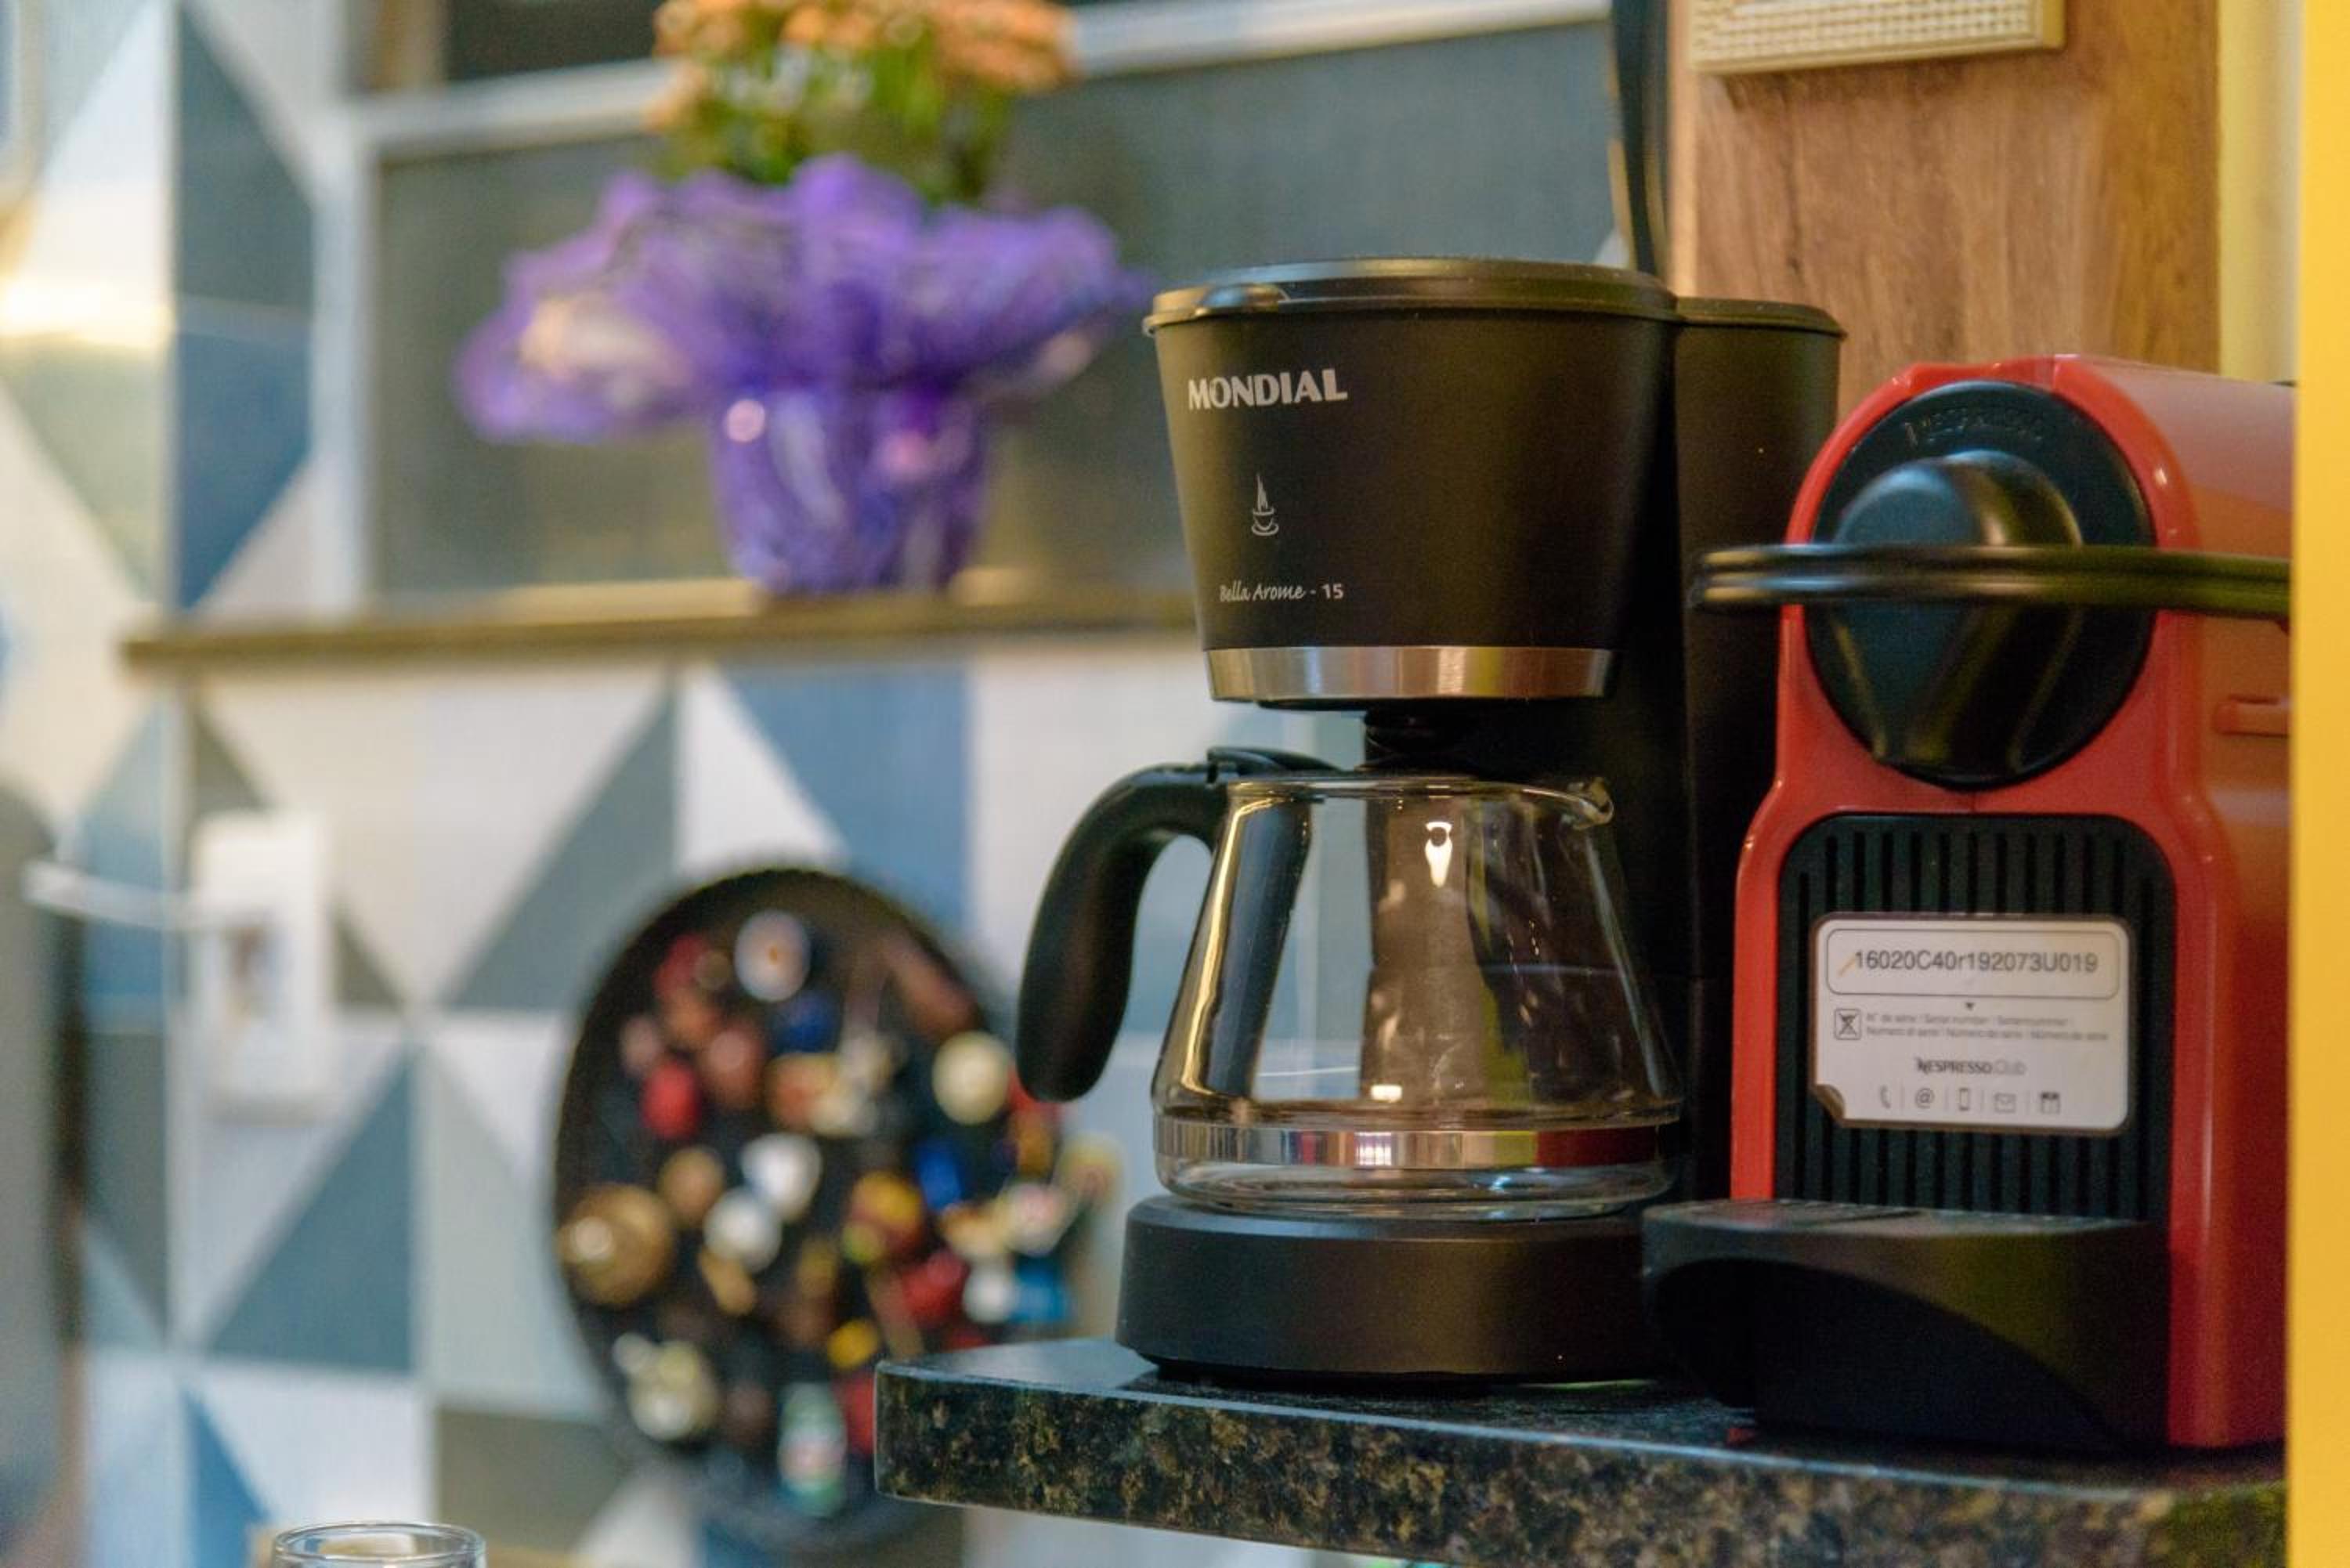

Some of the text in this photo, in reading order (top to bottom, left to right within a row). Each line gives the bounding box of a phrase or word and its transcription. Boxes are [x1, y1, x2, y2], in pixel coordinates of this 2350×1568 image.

[1188, 368, 1348, 410] MONDIAL
[1220, 580, 1251, 602] Bella
[1253, 583, 1306, 602] Arome
[1321, 583, 1344, 600] 15
[1914, 1057, 1992, 1075] NESPRESSO
